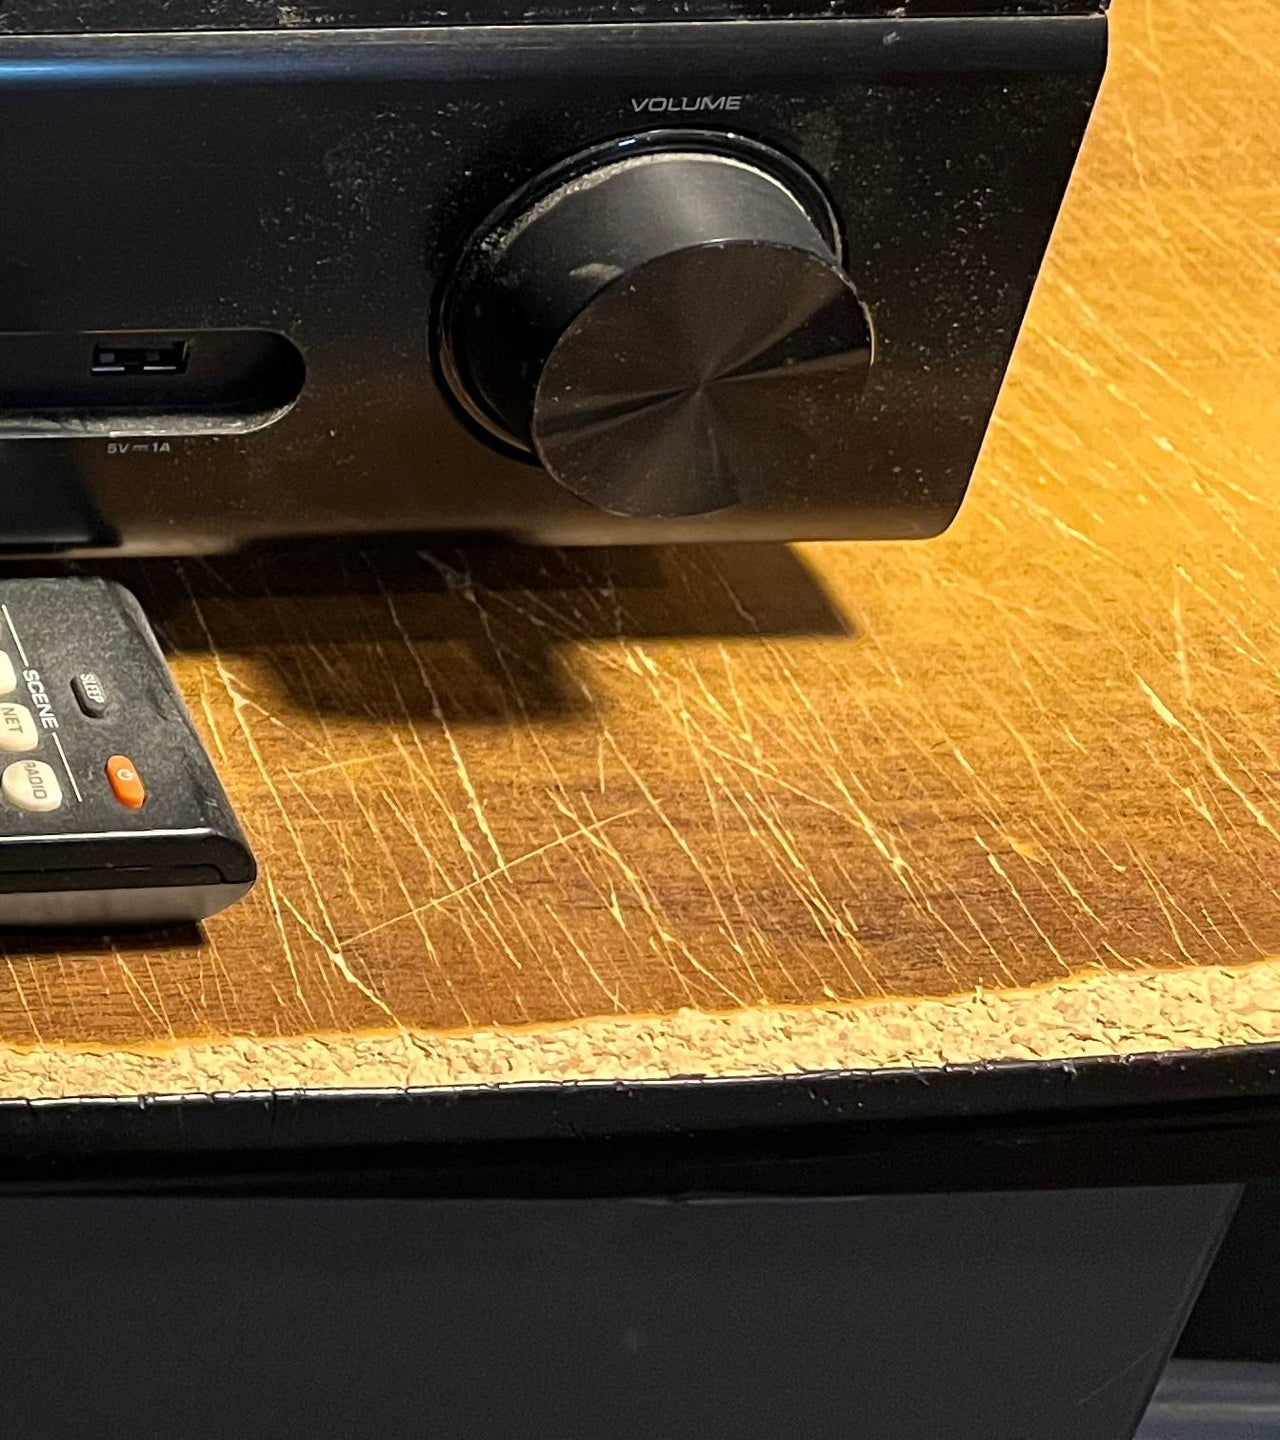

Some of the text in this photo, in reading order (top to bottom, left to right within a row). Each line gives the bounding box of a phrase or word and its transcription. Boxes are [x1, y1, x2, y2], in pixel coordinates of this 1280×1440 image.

[631, 96, 743, 113] VOLUME
[22, 669, 60, 730] SCENE
[79, 672, 106, 705] SLEEP
[1, 706, 24, 735] NET
[22, 762, 48, 801] RADIO
